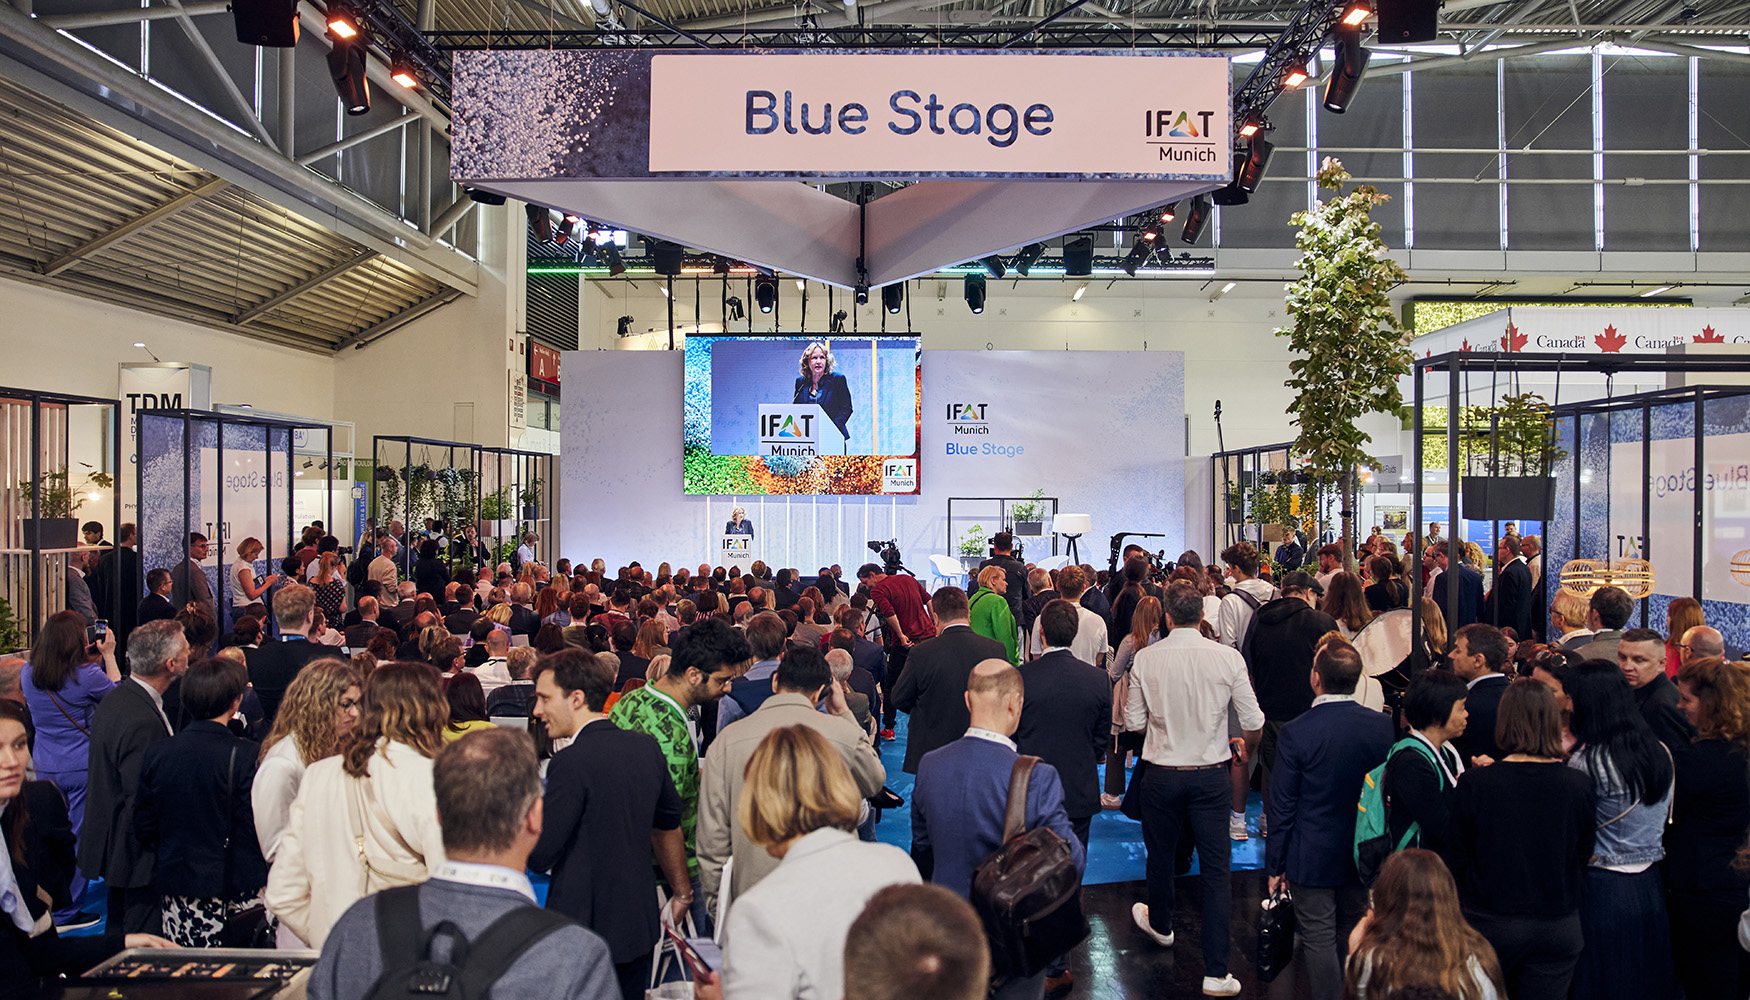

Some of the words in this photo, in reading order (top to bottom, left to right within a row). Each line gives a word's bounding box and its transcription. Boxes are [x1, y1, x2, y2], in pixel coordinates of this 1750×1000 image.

[745, 90, 869, 135] Blue
[888, 89, 1054, 148] Stage
[1145, 110, 1215, 138] IFAT
[1159, 146, 1217, 162] Munich
[1536, 334, 1586, 349] Canada
[1634, 335, 1684, 348] Canada
[538, 358, 546, 377] A
[126, 393, 182, 415] TDM
[946, 403, 989, 420] IFAT
[761, 414, 815, 438] IFAT
[954, 425, 990, 435] Munich
[771, 444, 815, 456] Munich
[946, 442, 978, 455] Blue
[981, 442, 1025, 458] Stage
[884, 465, 914, 477] IFAT
[722, 538, 749, 549] IFAT
